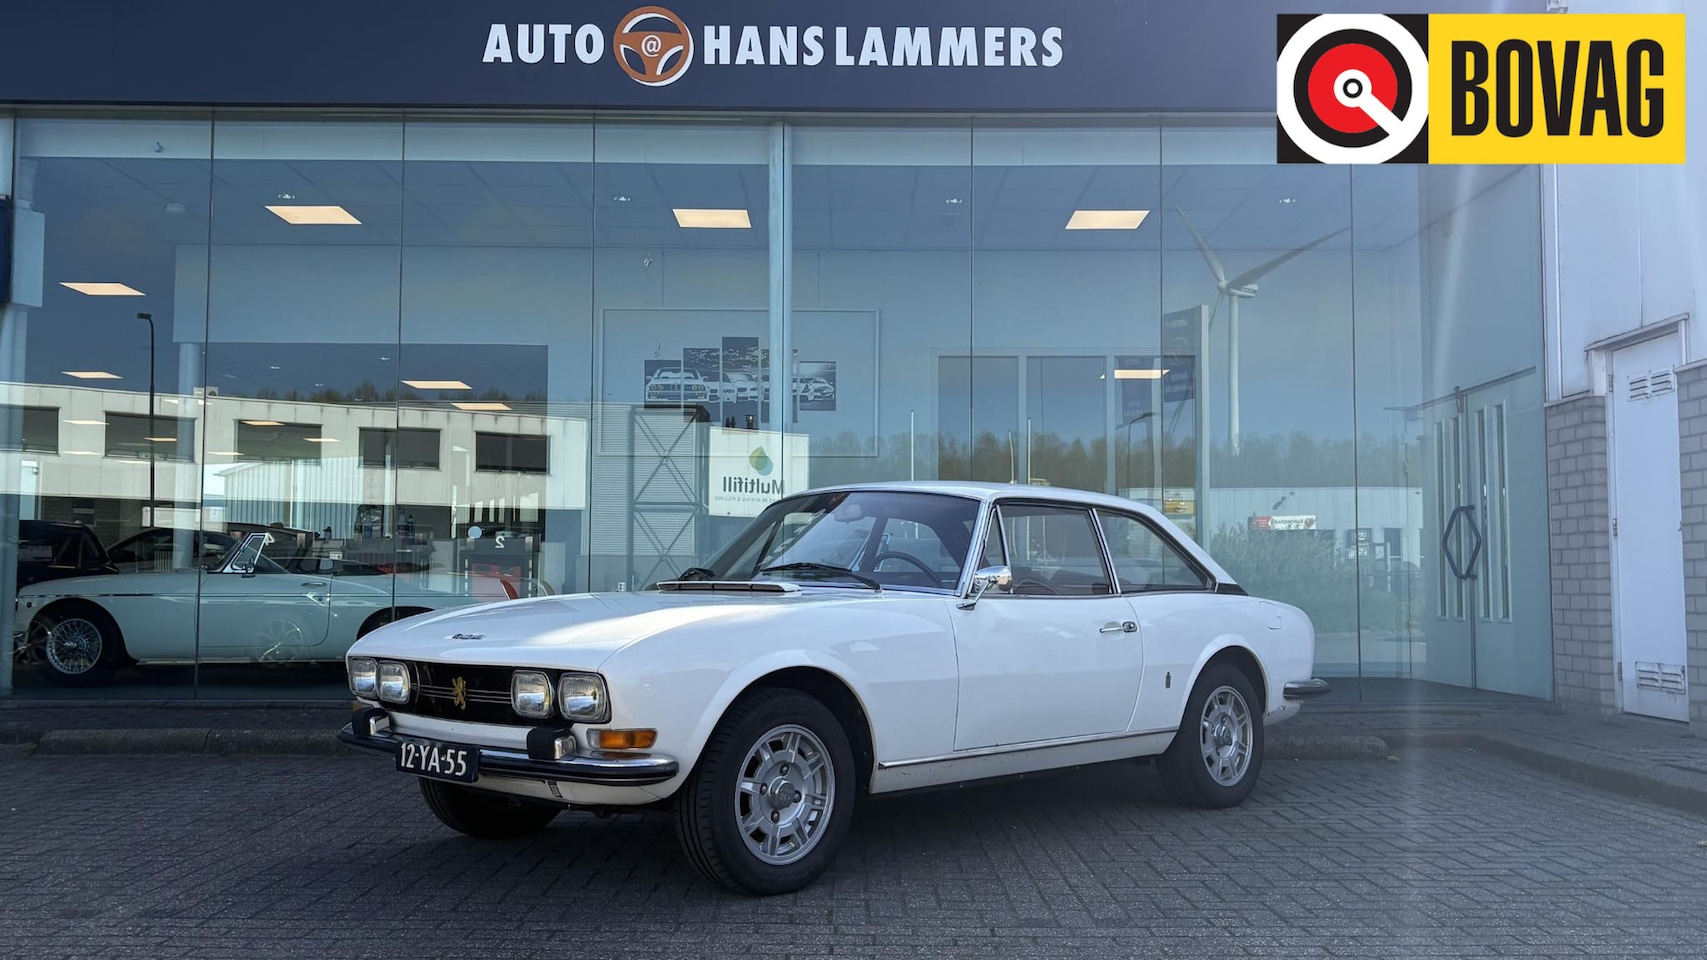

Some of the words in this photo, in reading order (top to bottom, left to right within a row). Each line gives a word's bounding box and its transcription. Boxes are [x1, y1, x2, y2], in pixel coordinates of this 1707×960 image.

[483, 24, 604, 64] AUTO
[641, 35, 662, 58] @
[704, 26, 824, 66] HANS
[835, 27, 1062, 67] LAMMERS
[400, 742, 467, 776] 12-YA-55
